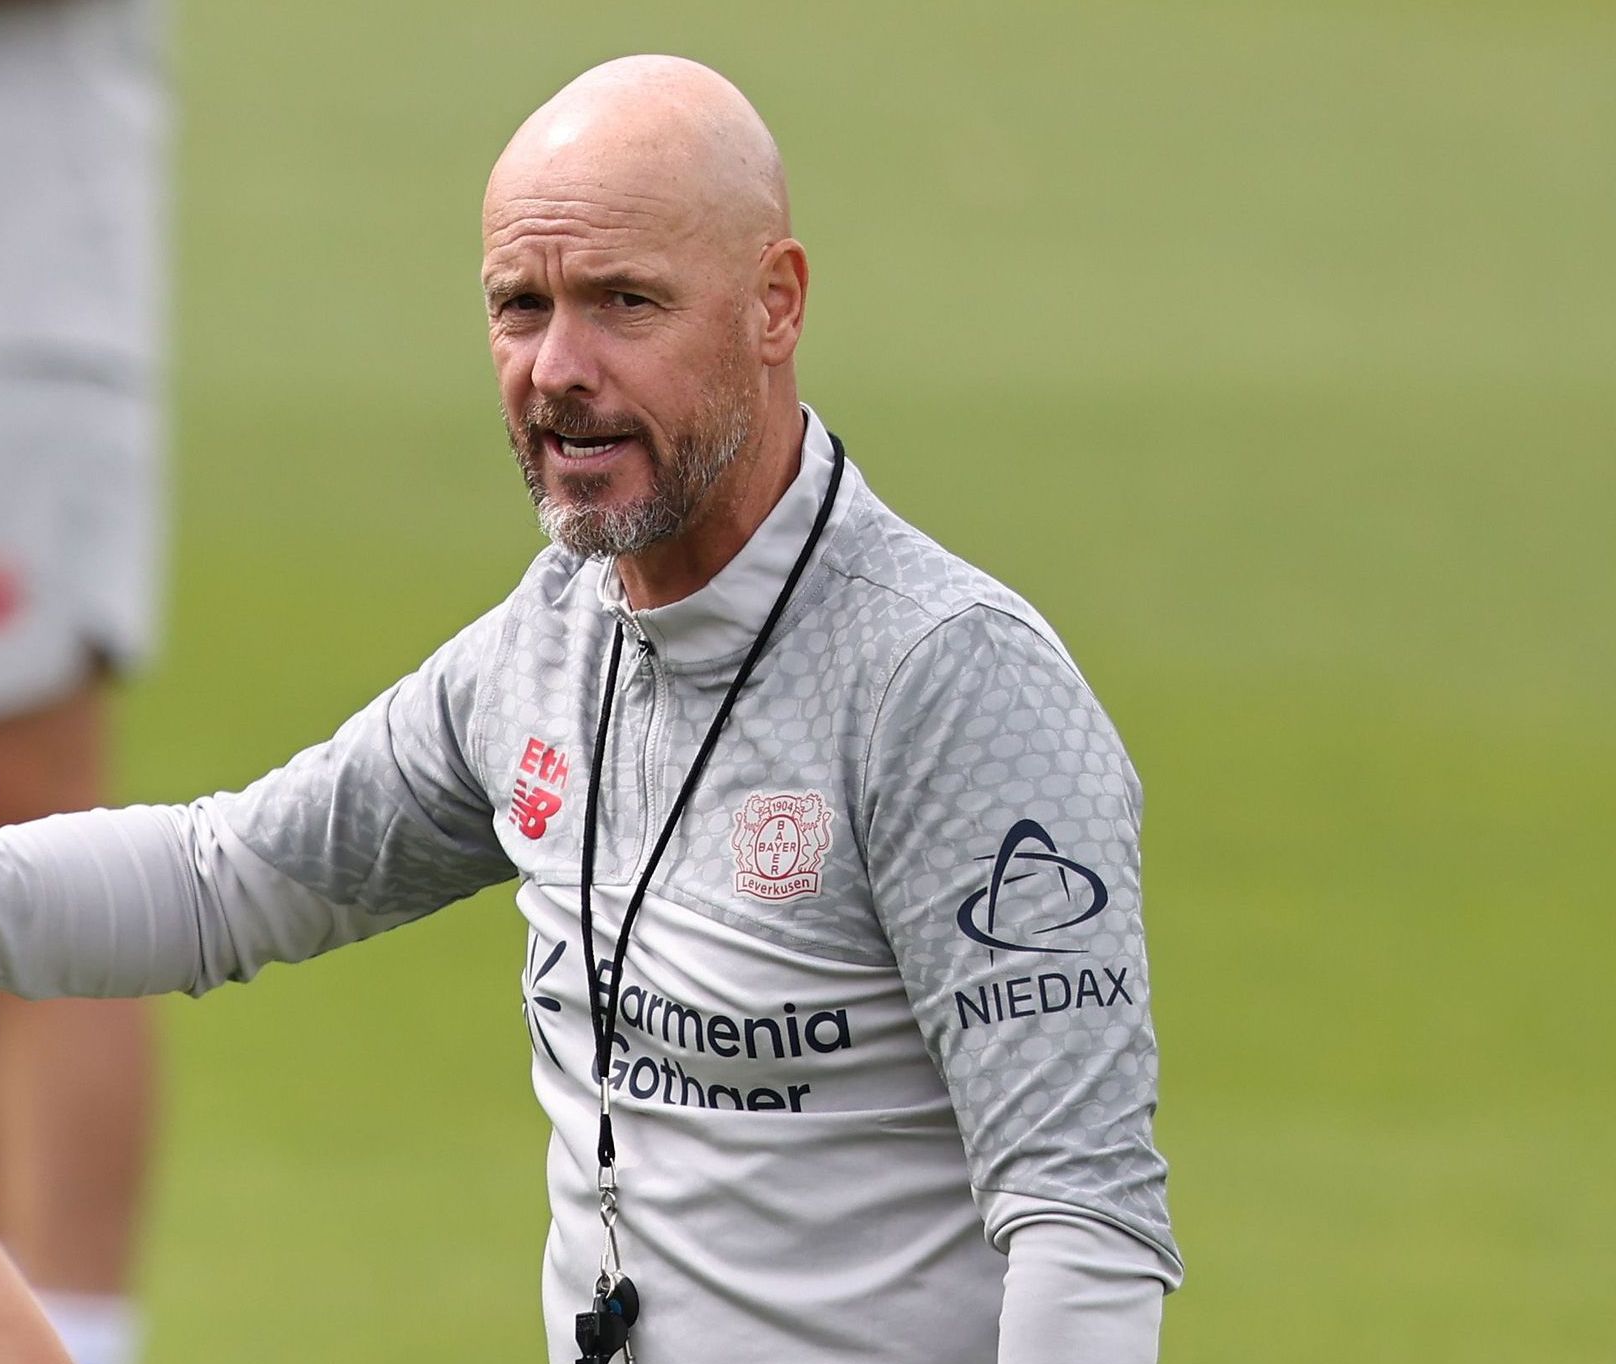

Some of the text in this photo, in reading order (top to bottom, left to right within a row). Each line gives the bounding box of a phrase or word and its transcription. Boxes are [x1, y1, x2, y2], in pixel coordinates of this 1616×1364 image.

[772, 800, 794, 814] 1904
[758, 842, 797, 853] BAYER
[770, 820, 785, 876] BAYER
[742, 875, 810, 896] Leverkusen
[954, 967, 1133, 1029] NIEDAX
